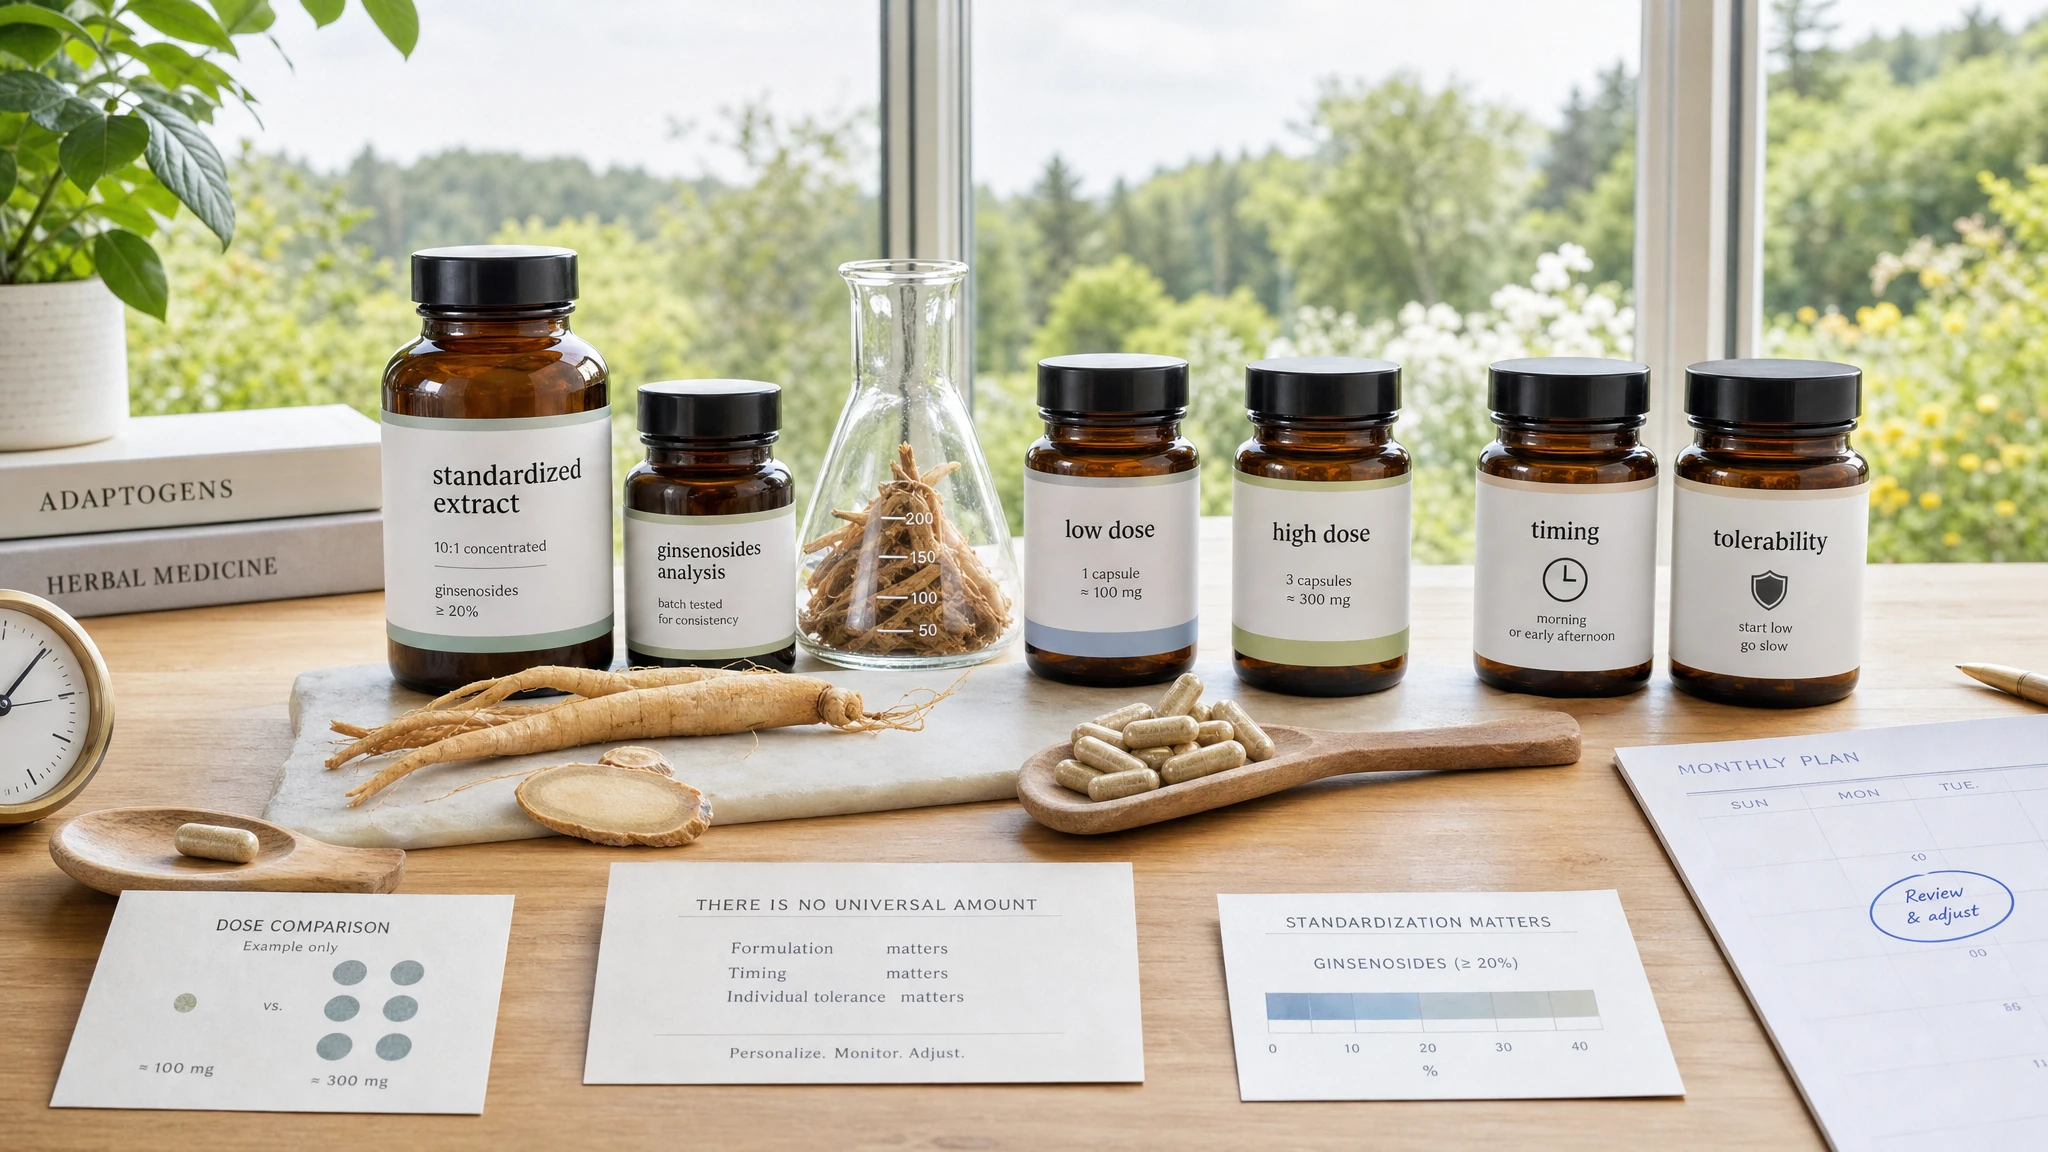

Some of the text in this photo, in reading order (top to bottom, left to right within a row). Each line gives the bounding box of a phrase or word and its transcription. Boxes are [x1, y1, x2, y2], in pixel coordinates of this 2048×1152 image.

[433, 457, 582, 487] standardized
[39, 479, 233, 512] ADAPTOGENS
[433, 493, 521, 515] extract
[904, 510, 935, 527] 200
[1065, 518, 1155, 540] low dose
[1272, 521, 1371, 548] high dose
[1530, 519, 1600, 546] timing
[434, 539, 547, 555] 10:1 concentrated
[1713, 529, 1828, 556] tolerability
[657, 540, 761, 562] ginsenosides
[909, 549, 938, 565] 150
[46, 556, 278, 596] HERBAL MEDICINE
[657, 563, 726, 585] analysis
[1082, 566, 1140, 583] 1 capsule
[1285, 573, 1352, 590] 3 capsules
[435, 583, 519, 599] ginsenosides
[910, 589, 939, 606] 100
[1093, 586, 1118, 599] 100
[1122, 588, 1143, 601] mg
[658, 597, 723, 610] batch tested
[1299, 593, 1325, 606] 300
[1329, 596, 1351, 609] mg
[448, 604, 479, 618] 20%
[658, 613, 740, 628] for consistency
[1536, 613, 1587, 629] morning
[1738, 621, 1793, 634] start low
[917, 622, 939, 638] 50
[1508, 628, 1615, 644] or early afternoon
[1740, 639, 1789, 654] go slow
[1677, 751, 1860, 776] MONTHLY PLAN
[1730, 780, 1979, 810] SUN MON TUE.
[1905, 887, 1964, 904] Review
[696, 898, 1038, 911] THERE IS NO UNIVERSAL AMOUNT
[1286, 916, 1551, 929] STANDARDIZATION MATTERS
[1907, 904, 1980, 927] & adjust
[216, 918, 390, 934] DOSE COMPARISON
[242, 940, 339, 956] Example only
[731, 941, 948, 955] Formulation matters
[1313, 957, 1447, 970] GINSENOSIDES
[1477, 956, 1518, 971] 20%)
[728, 966, 949, 983] Timing matters
[727, 990, 964, 1003] Individual tolerance matters
[263, 1002, 283, 1012] vs.
[729, 1046, 965, 1062] Personalize. Monitor. Adjust.
[1268, 1041, 1589, 1054] 0 10 20 30 40
[155, 1062, 185, 1074] 100
[190, 1065, 215, 1078] mg
[1422, 1064, 1439, 1077] %
[326, 1074, 358, 1087] 300
[364, 1077, 389, 1090] mg
